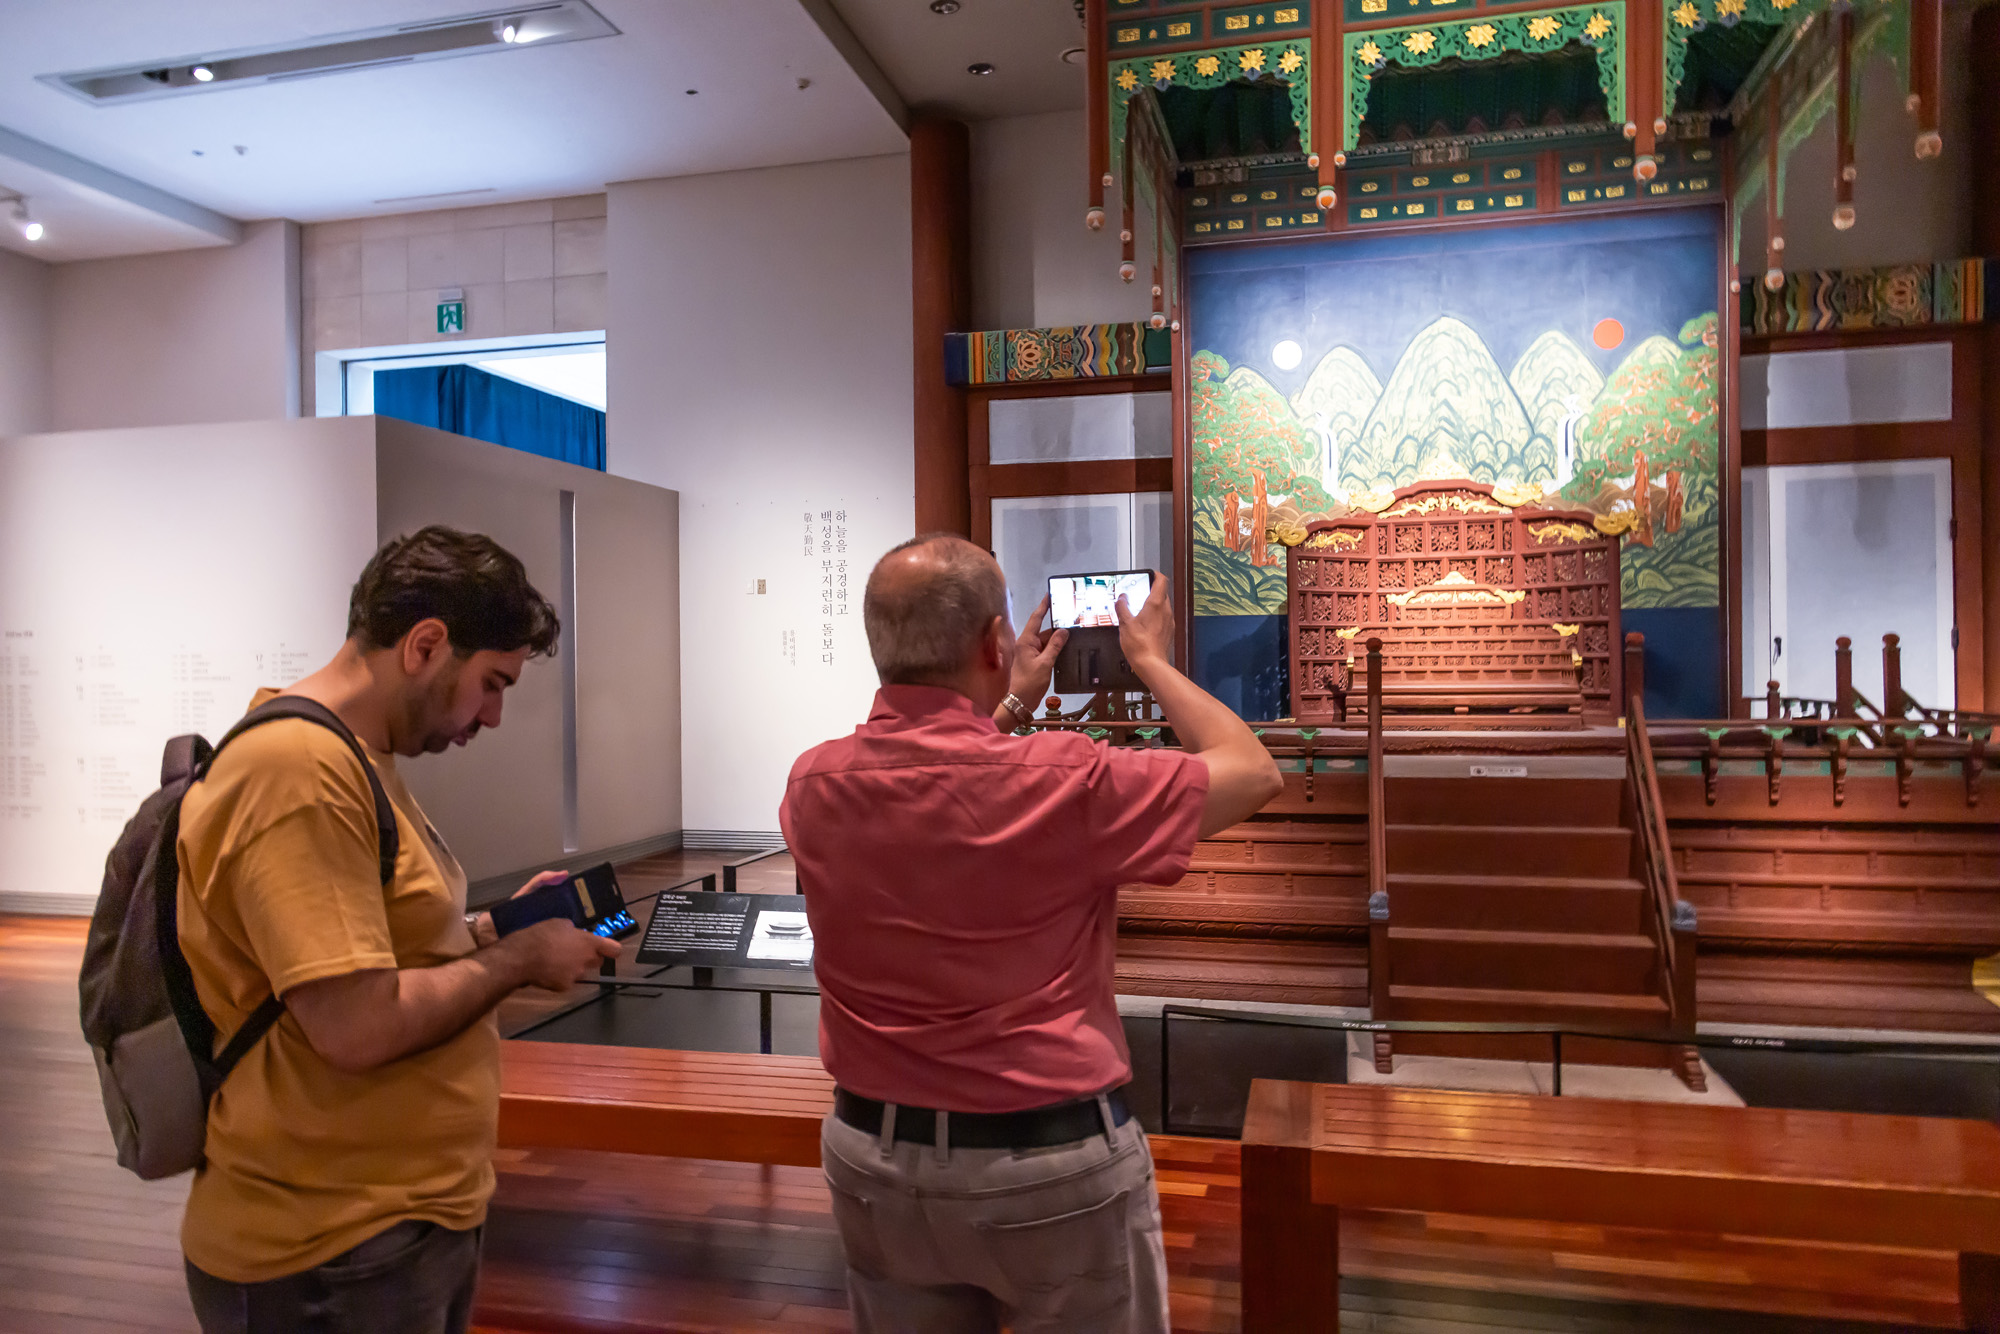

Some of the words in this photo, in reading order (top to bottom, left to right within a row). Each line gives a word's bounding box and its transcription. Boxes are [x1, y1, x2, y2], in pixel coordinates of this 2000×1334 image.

[820, 509, 833, 554] 백성을
[835, 509, 848, 553] 하늘을
[821, 559, 833, 617] 부지런히
[835, 559, 849, 615] 공경하고
[821, 623, 835, 666] 돌보다
